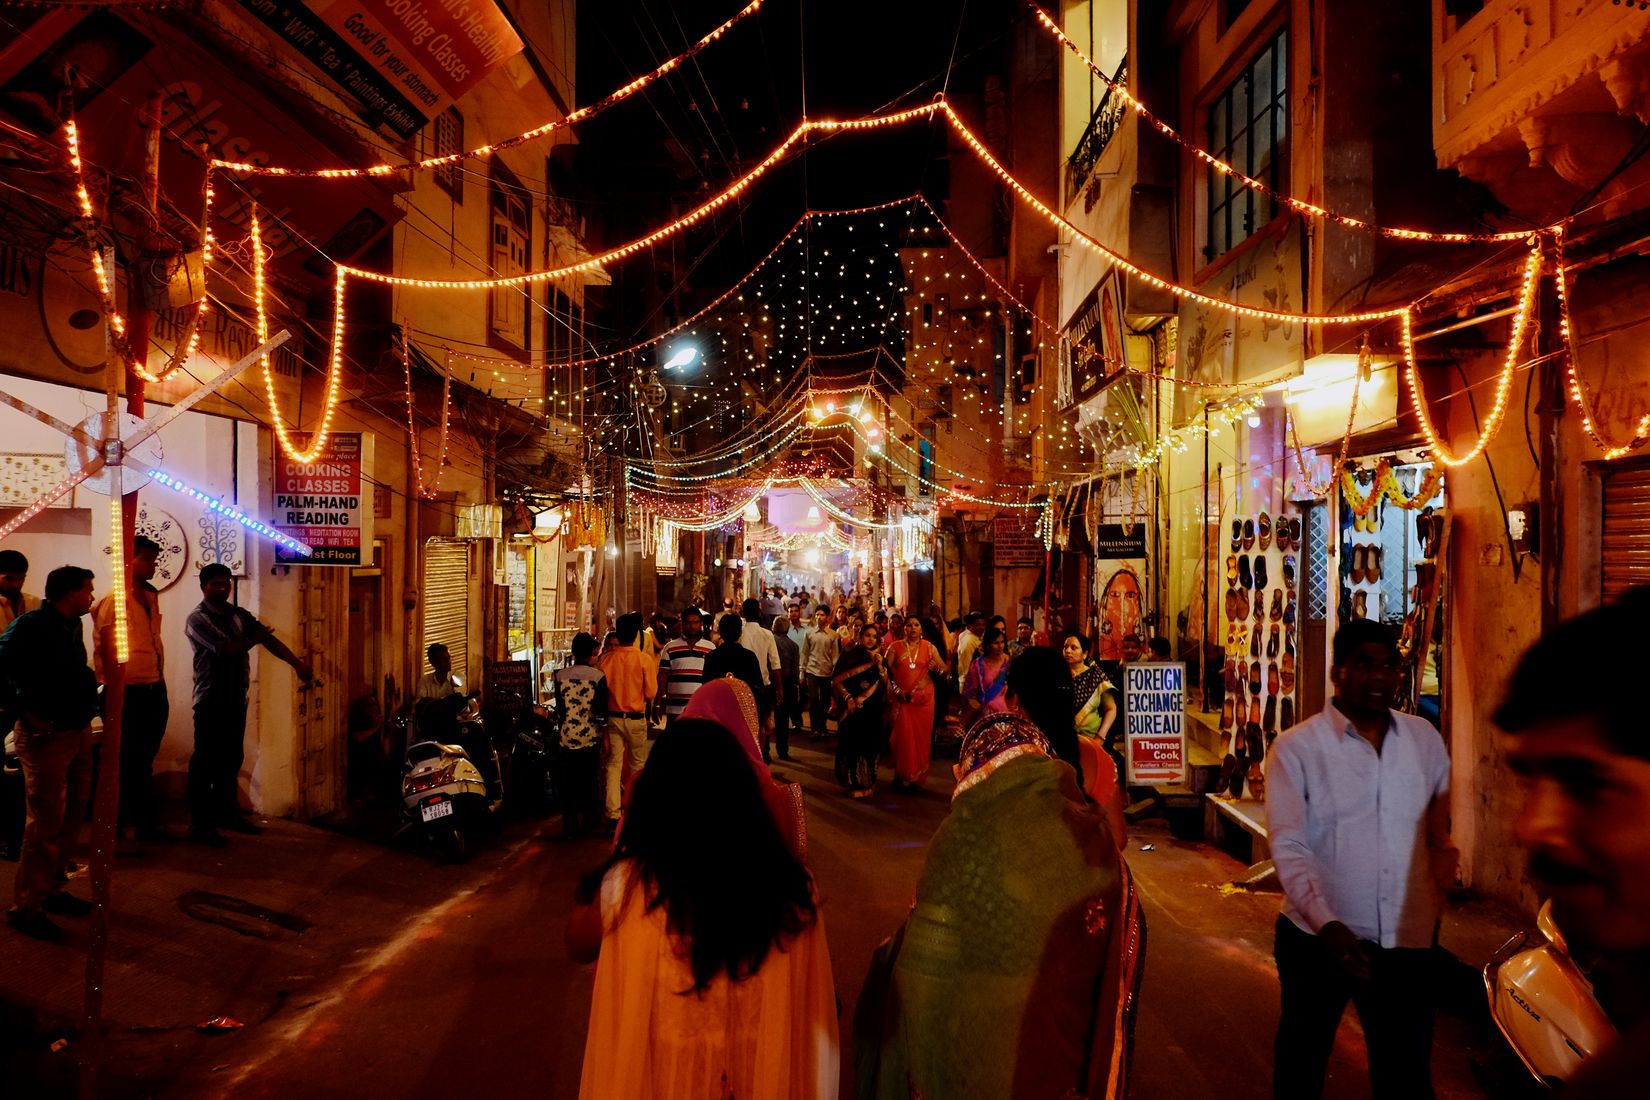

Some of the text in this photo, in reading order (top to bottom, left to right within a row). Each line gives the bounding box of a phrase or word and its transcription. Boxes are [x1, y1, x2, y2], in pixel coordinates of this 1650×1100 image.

[459, 10, 505, 68] Healthy
[343, 12, 440, 108] Good for your stomach
[427, 33, 471, 83] Classes
[283, 16, 318, 48] WiFi
[319, 46, 341, 70] Tea
[344, 67, 389, 111] Paintings
[382, 102, 417, 133] Exhibit
[285, 463, 352, 477] COOKING
[286, 479, 350, 493] CLASSES
[277, 495, 359, 509] PALM-HAND
[286, 511, 349, 525] READING
[310, 528, 341, 537] MEDITATION
[342, 529, 359, 537] ROOM
[309, 537, 325, 545] READ
[343, 538, 354, 546] TEA
[328, 550, 357, 560] Floor
[1127, 668, 1182, 691] FOREIGN
[1127, 692, 1184, 713] EXCHANGE
[1128, 714, 1181, 735] BUREAU
[1138, 740, 1180, 750] Thomas
[1153, 750, 1180, 760] Cook
[1504, 988, 1541, 1022] Activa
